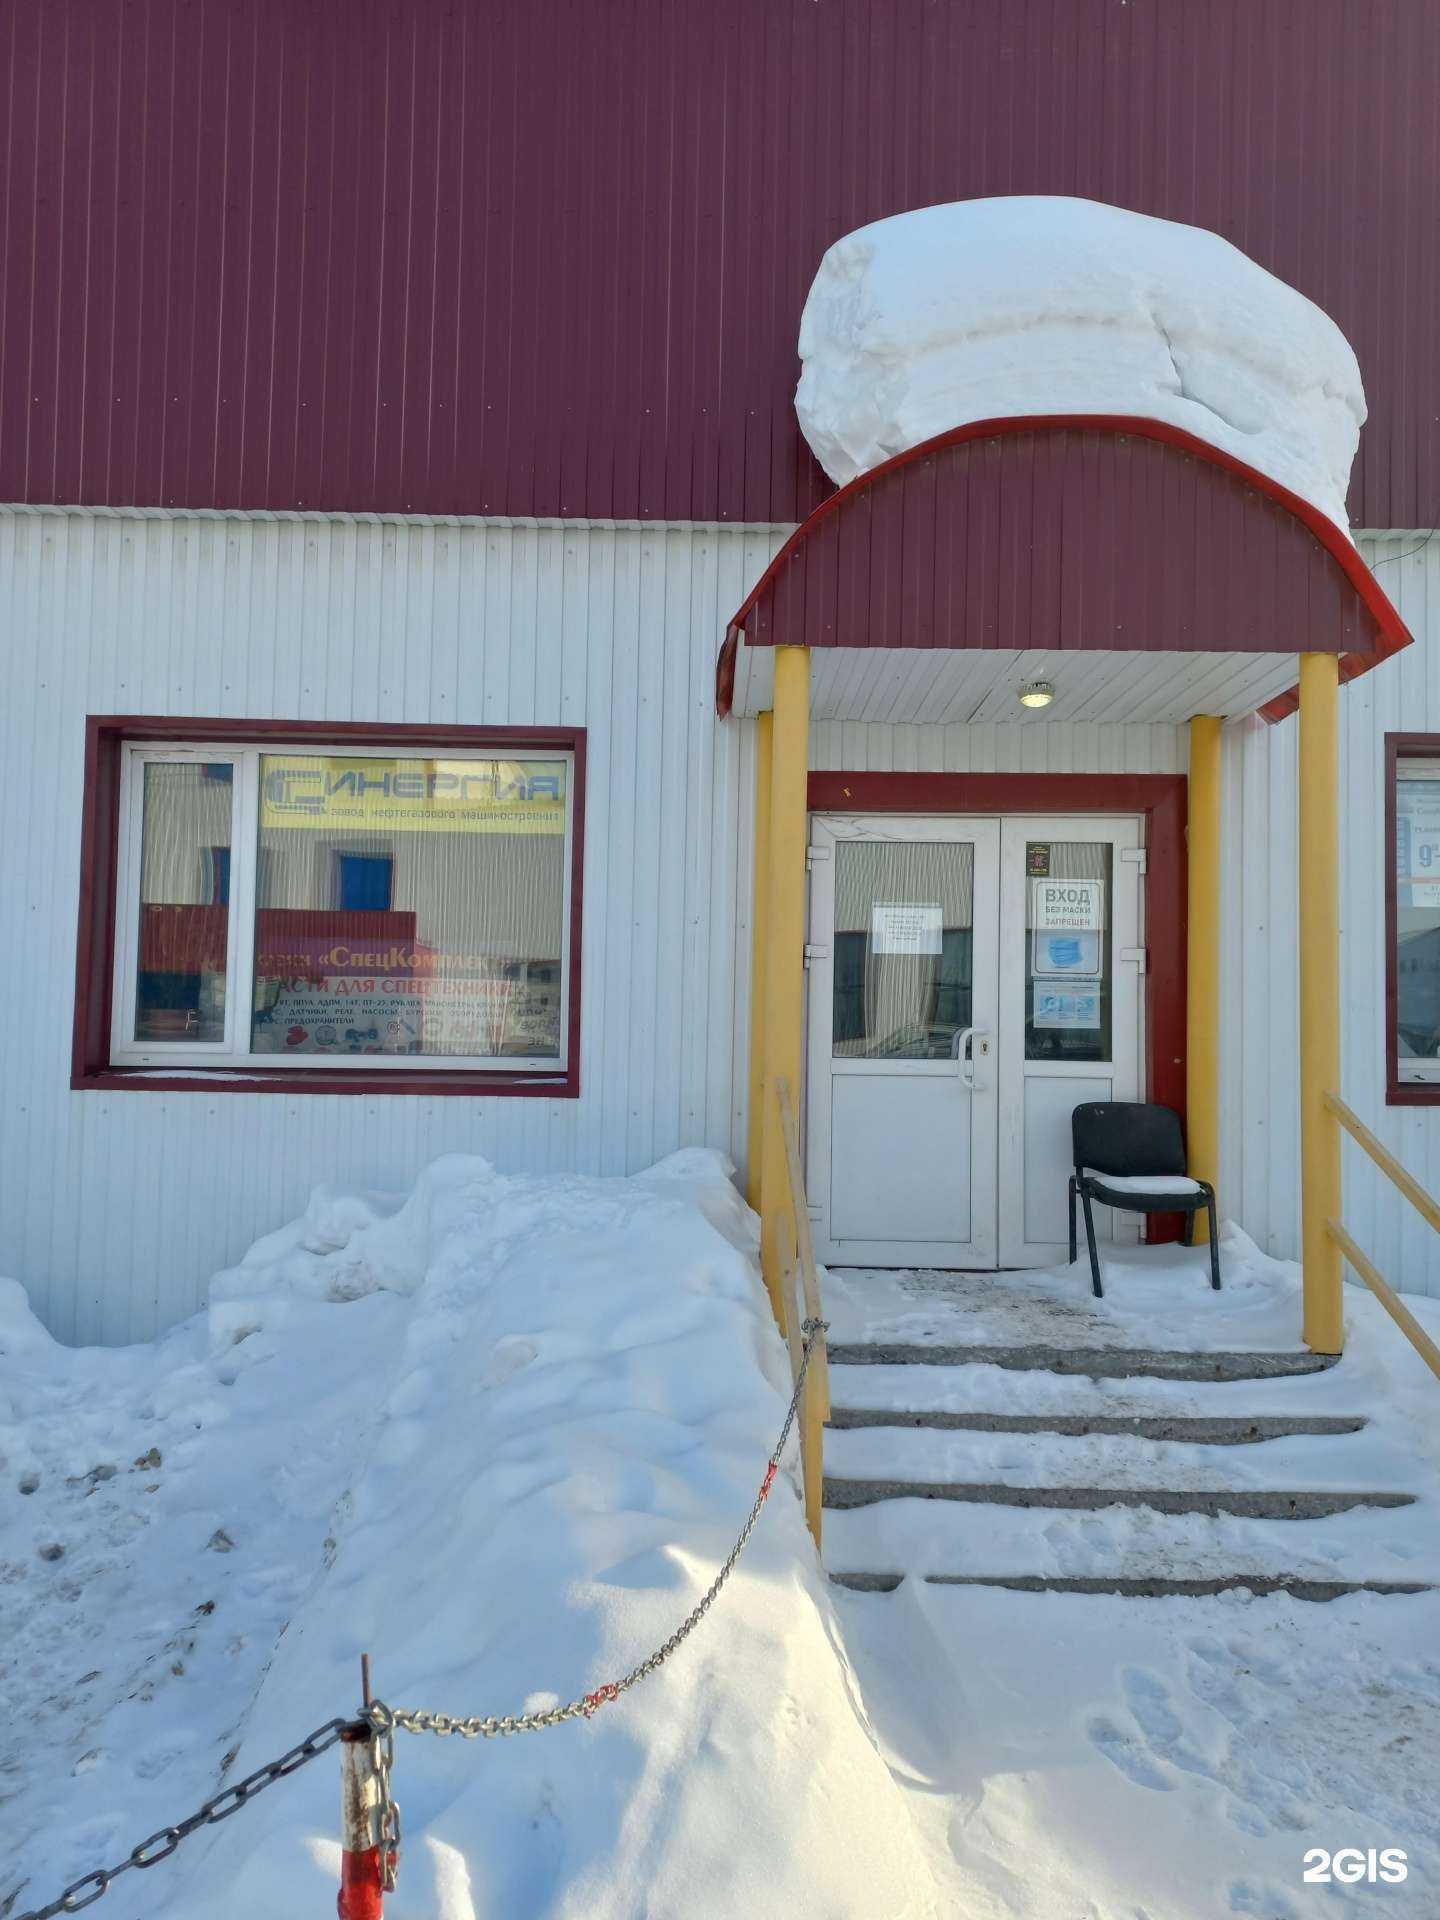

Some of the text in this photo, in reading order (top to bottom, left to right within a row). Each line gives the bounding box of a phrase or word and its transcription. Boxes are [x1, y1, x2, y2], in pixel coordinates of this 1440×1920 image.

[372, 807, 455, 820] нефтегазового
[461, 810, 560, 823] машиностроения
[1045, 888, 1091, 905] ВХОД
[1045, 905, 1091, 914] БЕЗ МАСКИ
[334, 979, 376, 996] ДЛЯ
